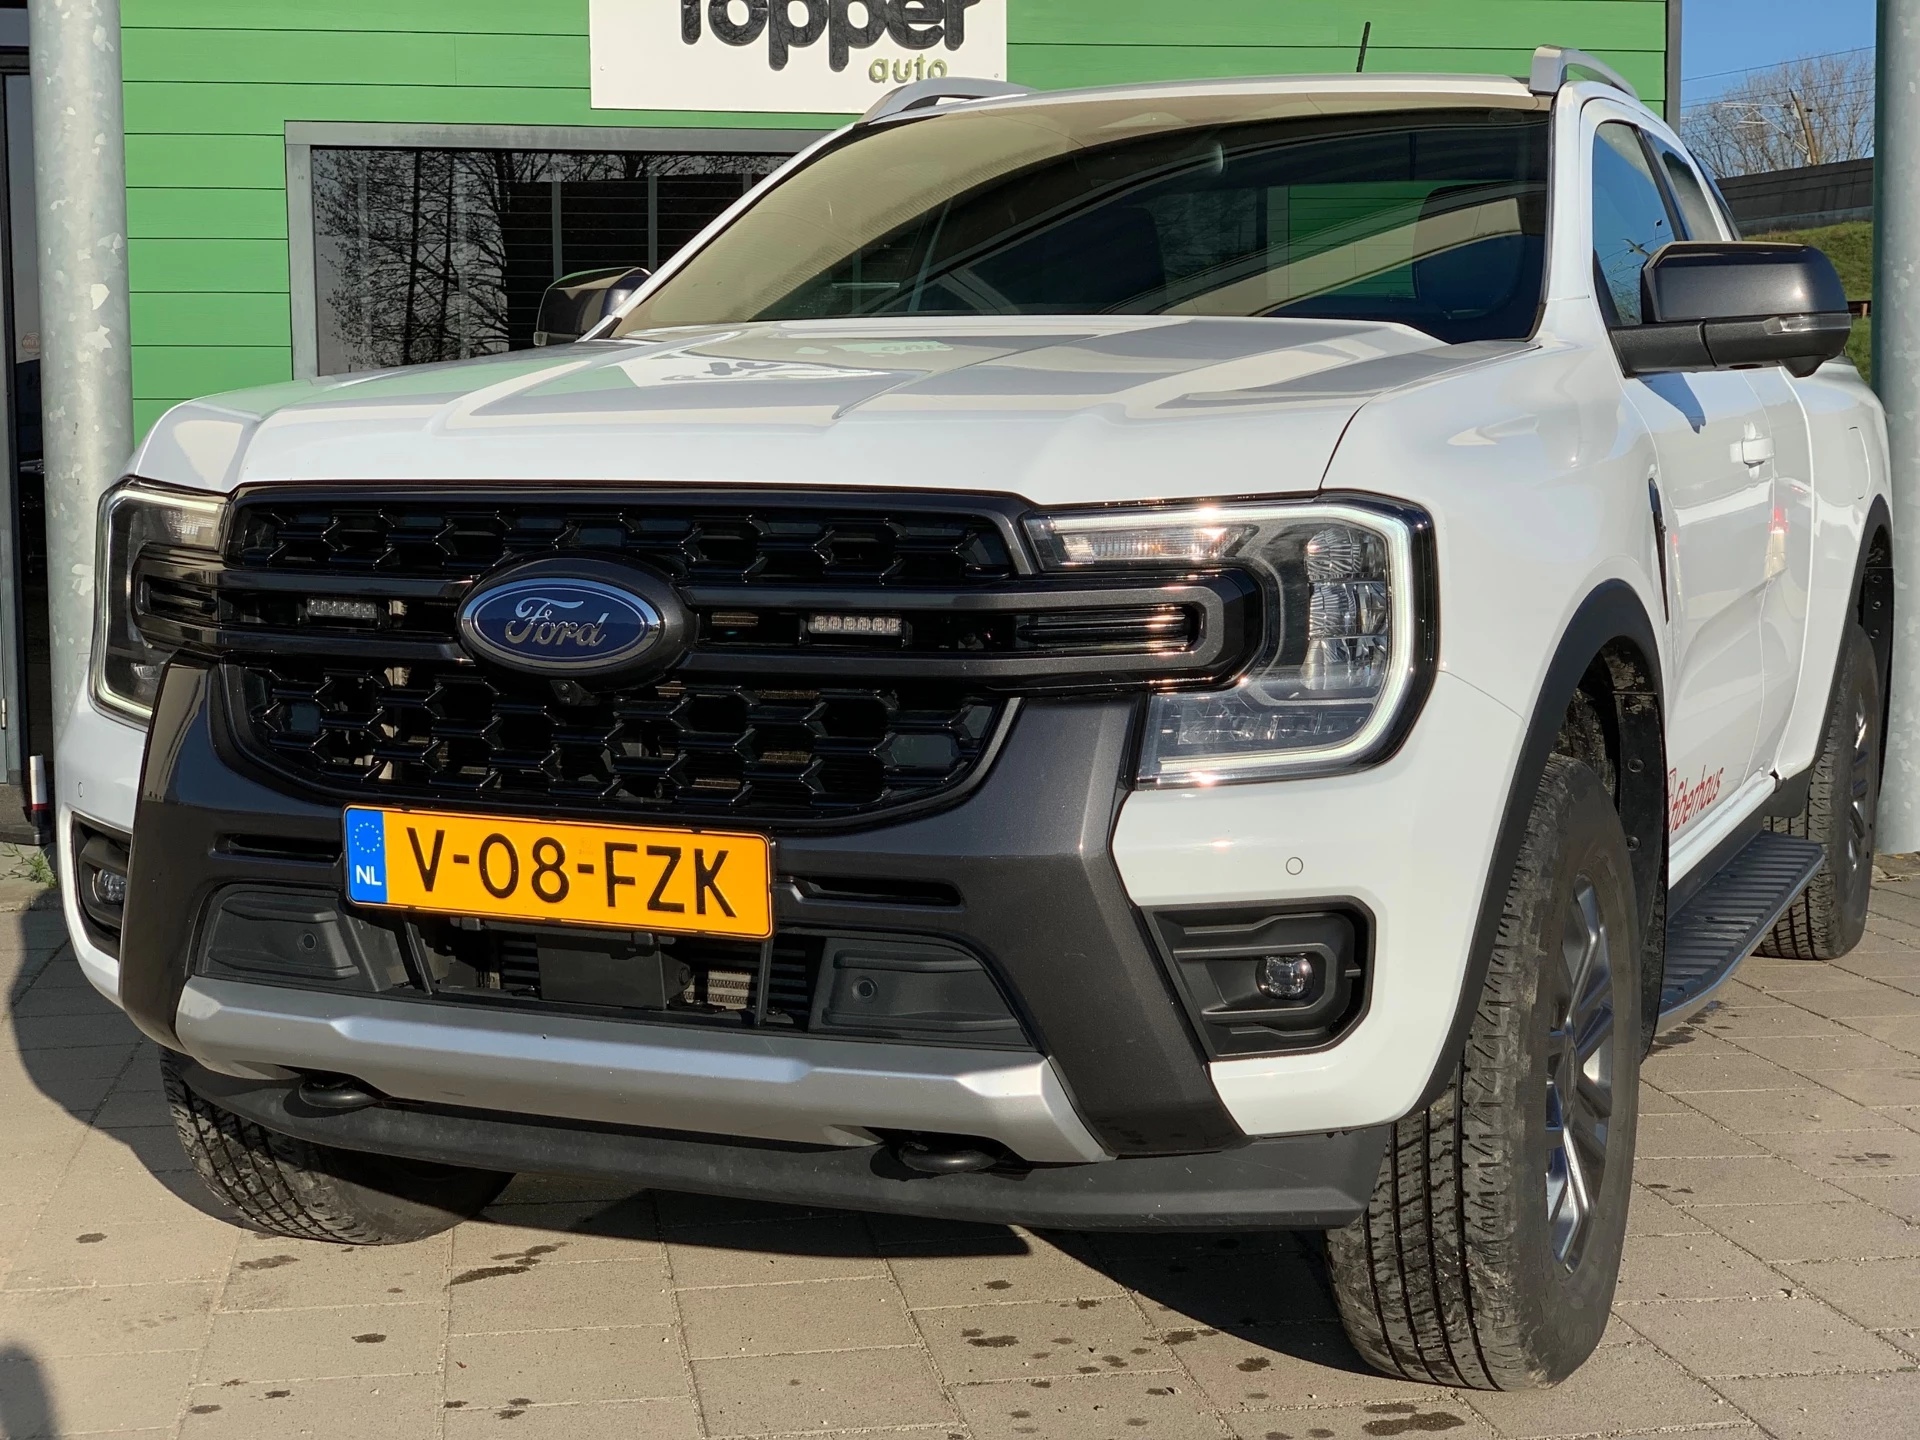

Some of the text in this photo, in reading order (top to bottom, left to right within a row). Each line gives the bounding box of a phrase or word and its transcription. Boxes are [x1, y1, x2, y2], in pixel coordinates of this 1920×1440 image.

[868, 53, 948, 83] auto
[504, 597, 610, 646] Ford
[355, 864, 383, 886] NL
[407, 827, 737, 918] V-08-FZK
